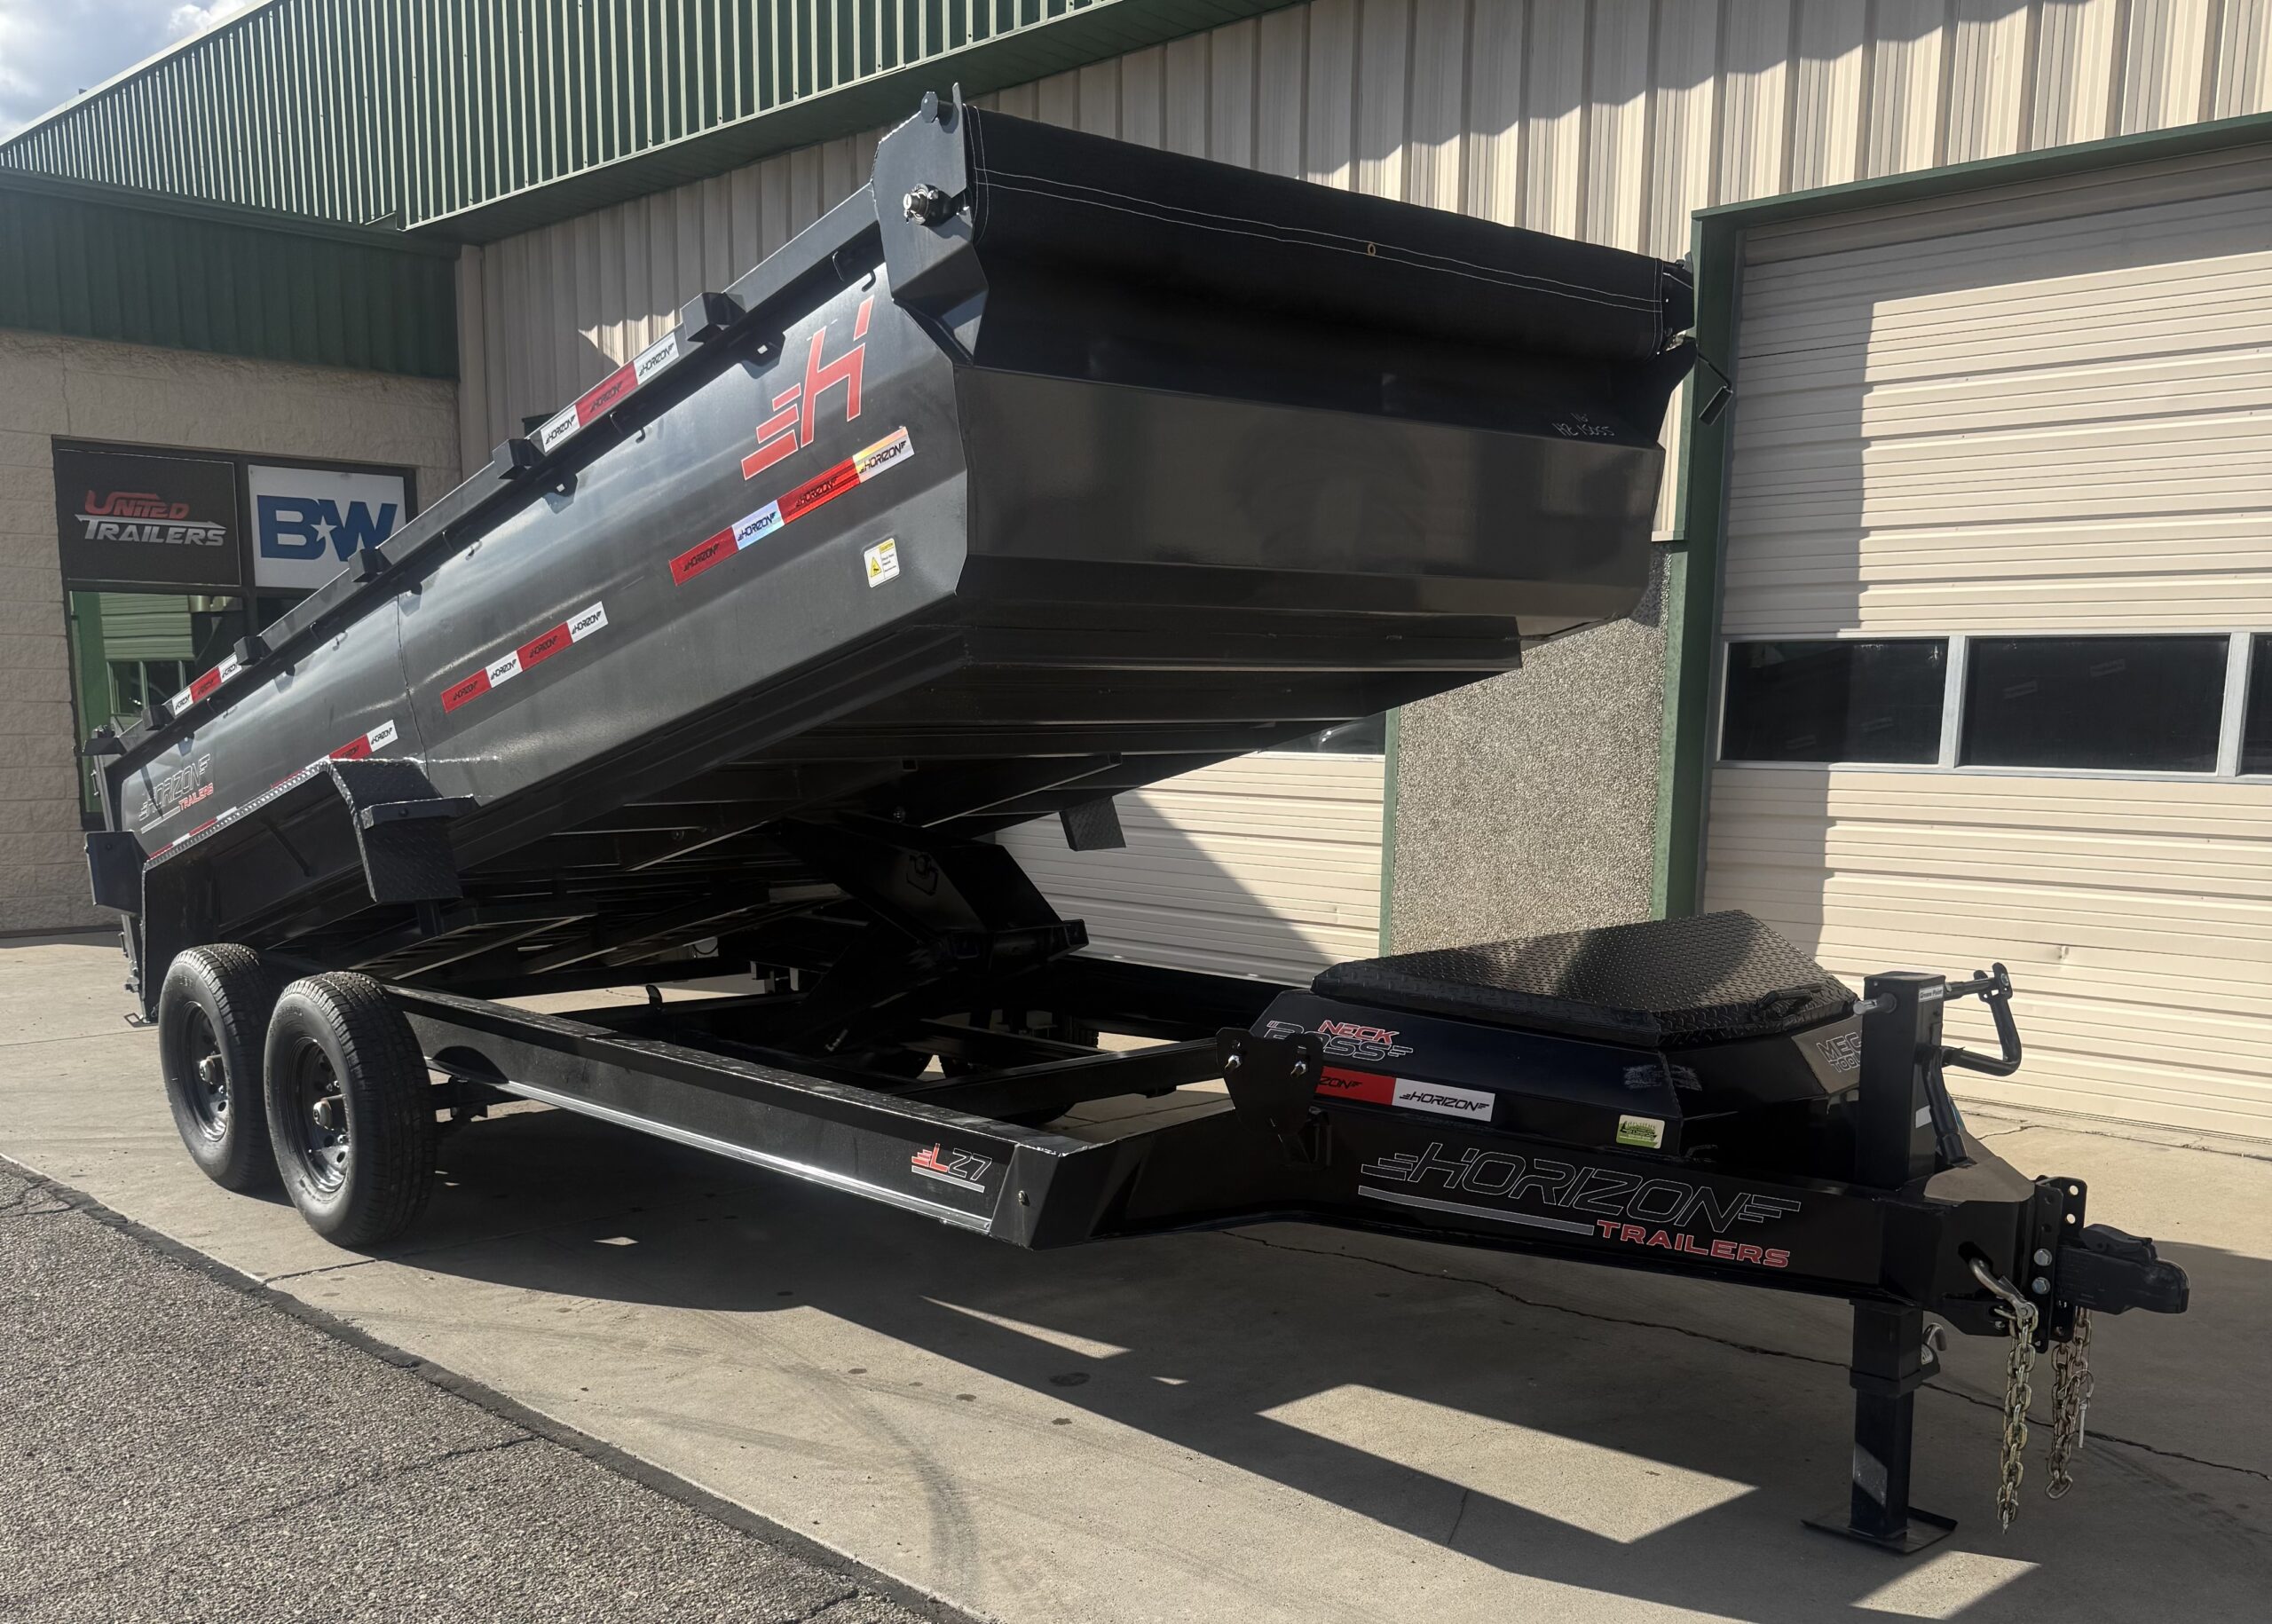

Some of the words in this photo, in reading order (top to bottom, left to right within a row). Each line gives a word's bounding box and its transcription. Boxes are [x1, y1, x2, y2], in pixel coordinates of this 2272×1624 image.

[547, 416, 574, 443] HORIZON
[592, 383, 621, 411] HORIZON
[641, 344, 672, 374] HORIZON
[84, 490, 190, 519] UNITED
[685, 545, 717, 570] HORIZON
[739, 513, 775, 540] HORIZON
[798, 479, 835, 506] HORIZON
[862, 443, 904, 471] HORIZON
[76, 515, 226, 547] TRAILERS
[454, 682, 477, 700] HORIZON
[492, 659, 516, 680] HORIZON
[531, 636, 556, 658] HORIZON
[572, 611, 600, 634] HORIZON
[372, 728, 392, 744] HORIZON
[178, 782, 213, 811] TRAILERS
[1318, 1019, 1400, 1045] NECK
[1404, 1091, 1485, 1111] HORIZON
[1386, 1142, 1775, 1233] HORIZON
[1598, 1220, 1790, 1267] TRAILERS
